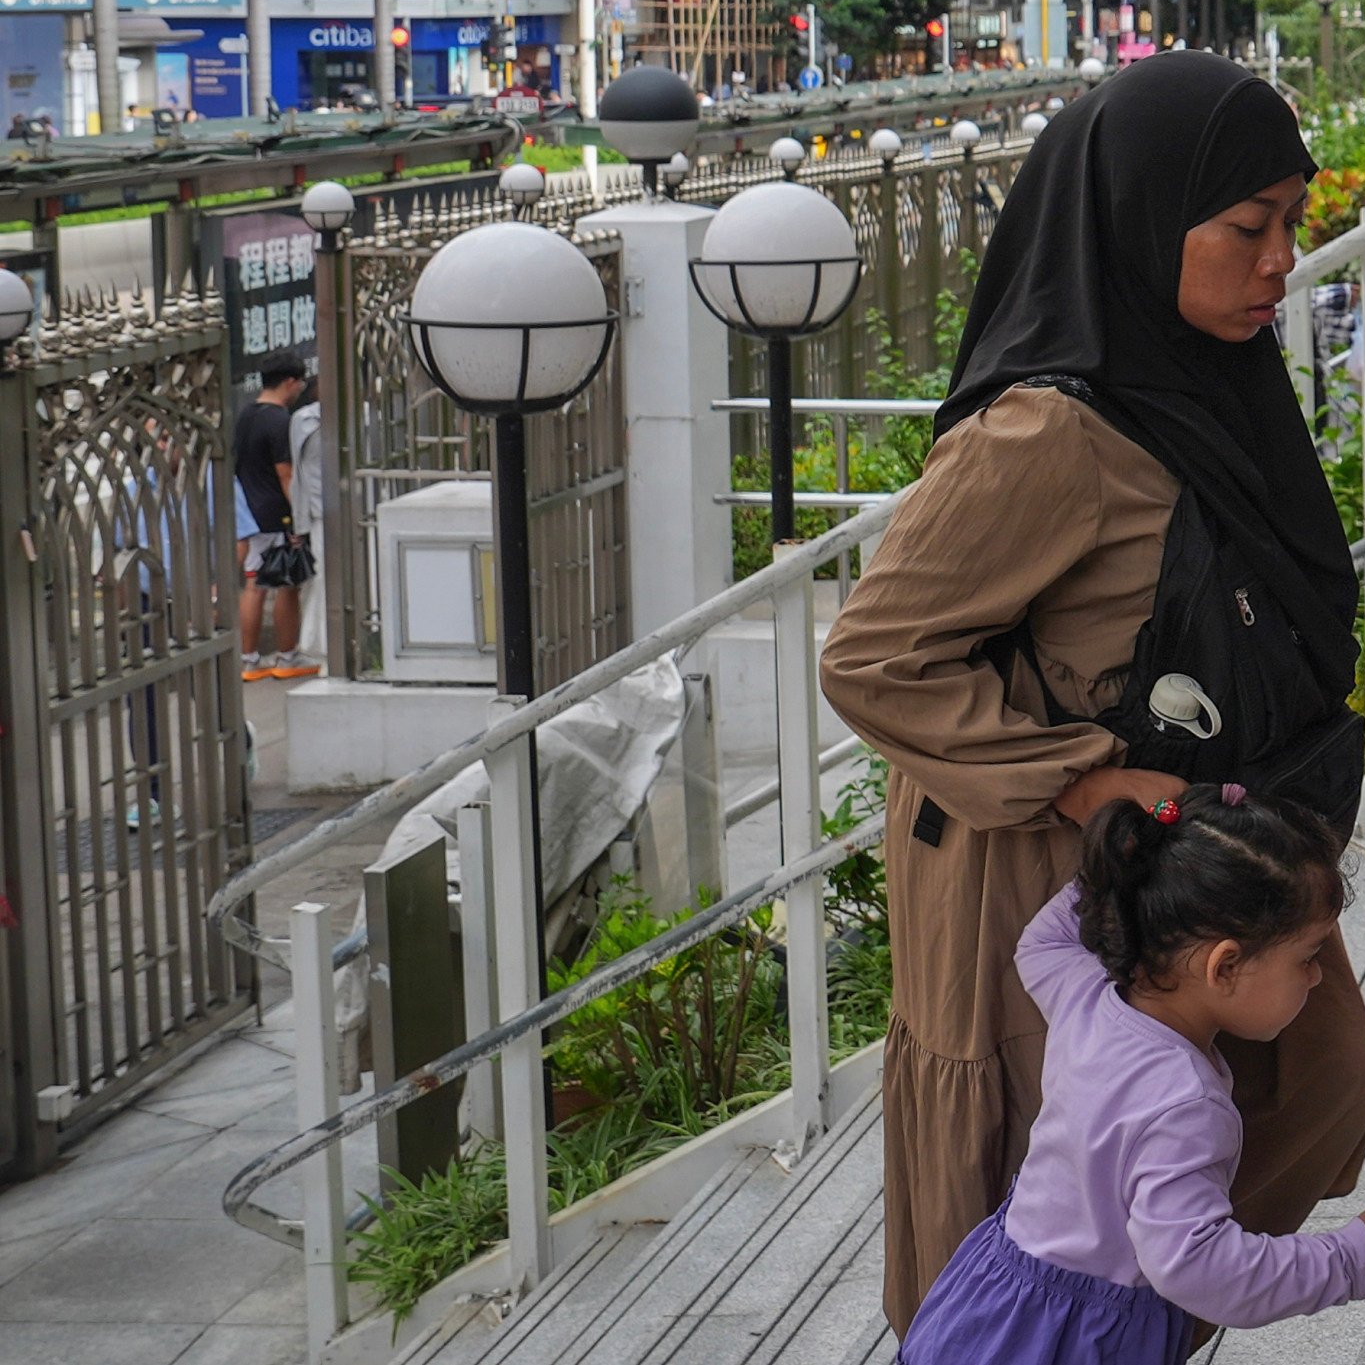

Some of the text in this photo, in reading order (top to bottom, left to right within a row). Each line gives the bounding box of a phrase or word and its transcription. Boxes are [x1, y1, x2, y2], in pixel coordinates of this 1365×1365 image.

[309, 22, 377, 47] citiba
[239, 232, 322, 292] 程程都
